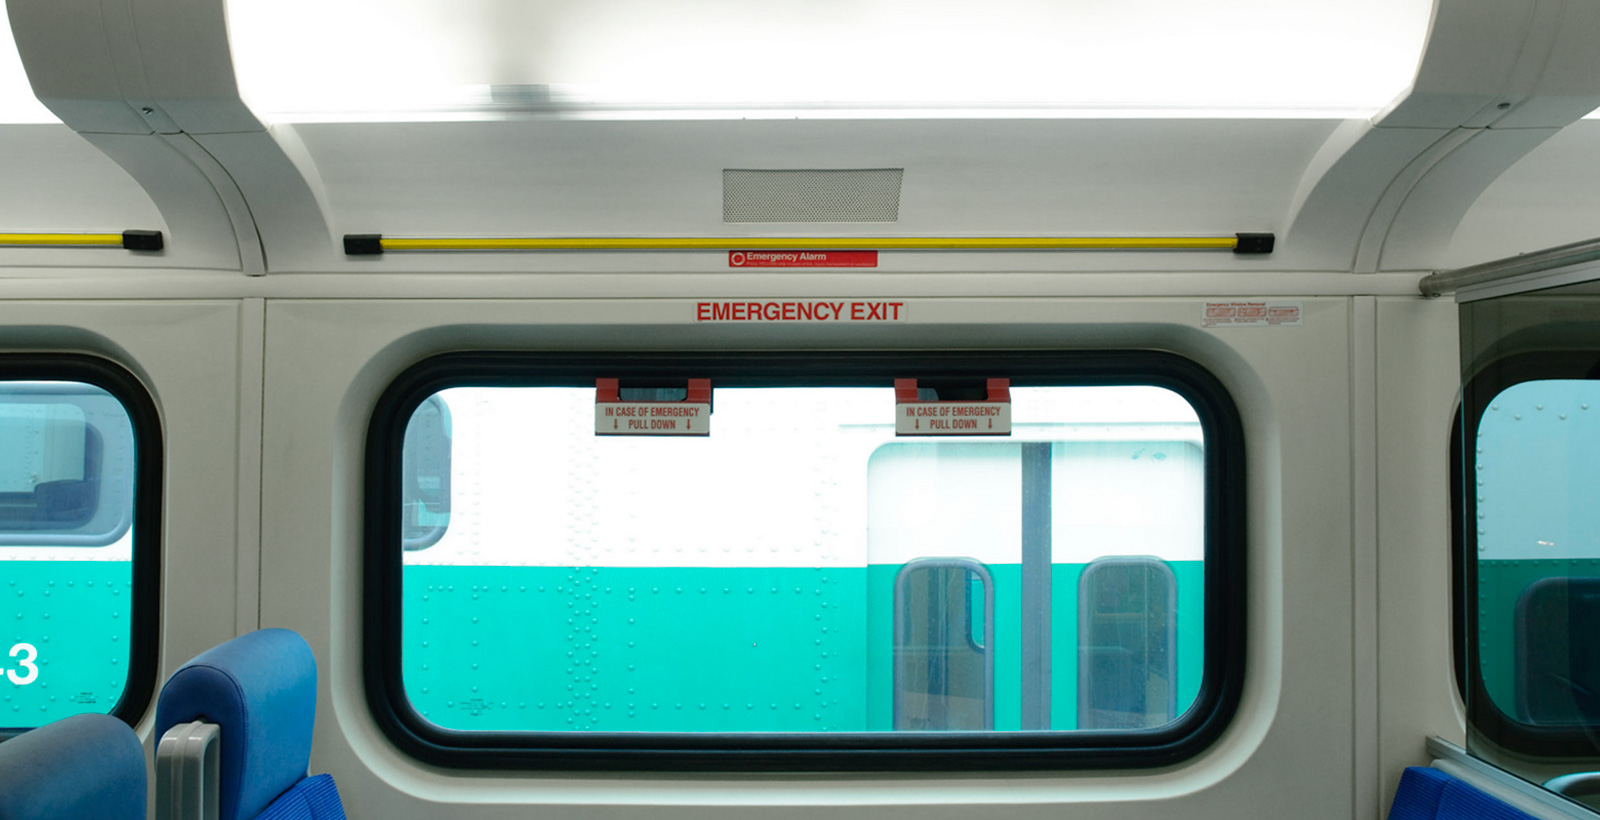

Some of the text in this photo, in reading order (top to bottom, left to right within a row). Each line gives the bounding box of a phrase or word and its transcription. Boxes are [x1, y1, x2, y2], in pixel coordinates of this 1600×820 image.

[747, 252, 827, 262] Emergency Alarm
[697, 302, 903, 320] EMERGENCY EXIT
[605, 407, 699, 417] IN CASE OF EMERGENCY
[906, 406, 1001, 417] IN CASE OF EMERGENCY
[628, 420, 676, 429] PULL DOWN
[930, 419, 977, 429] PULL DOWN
[0, 643, 39, 685] 3
